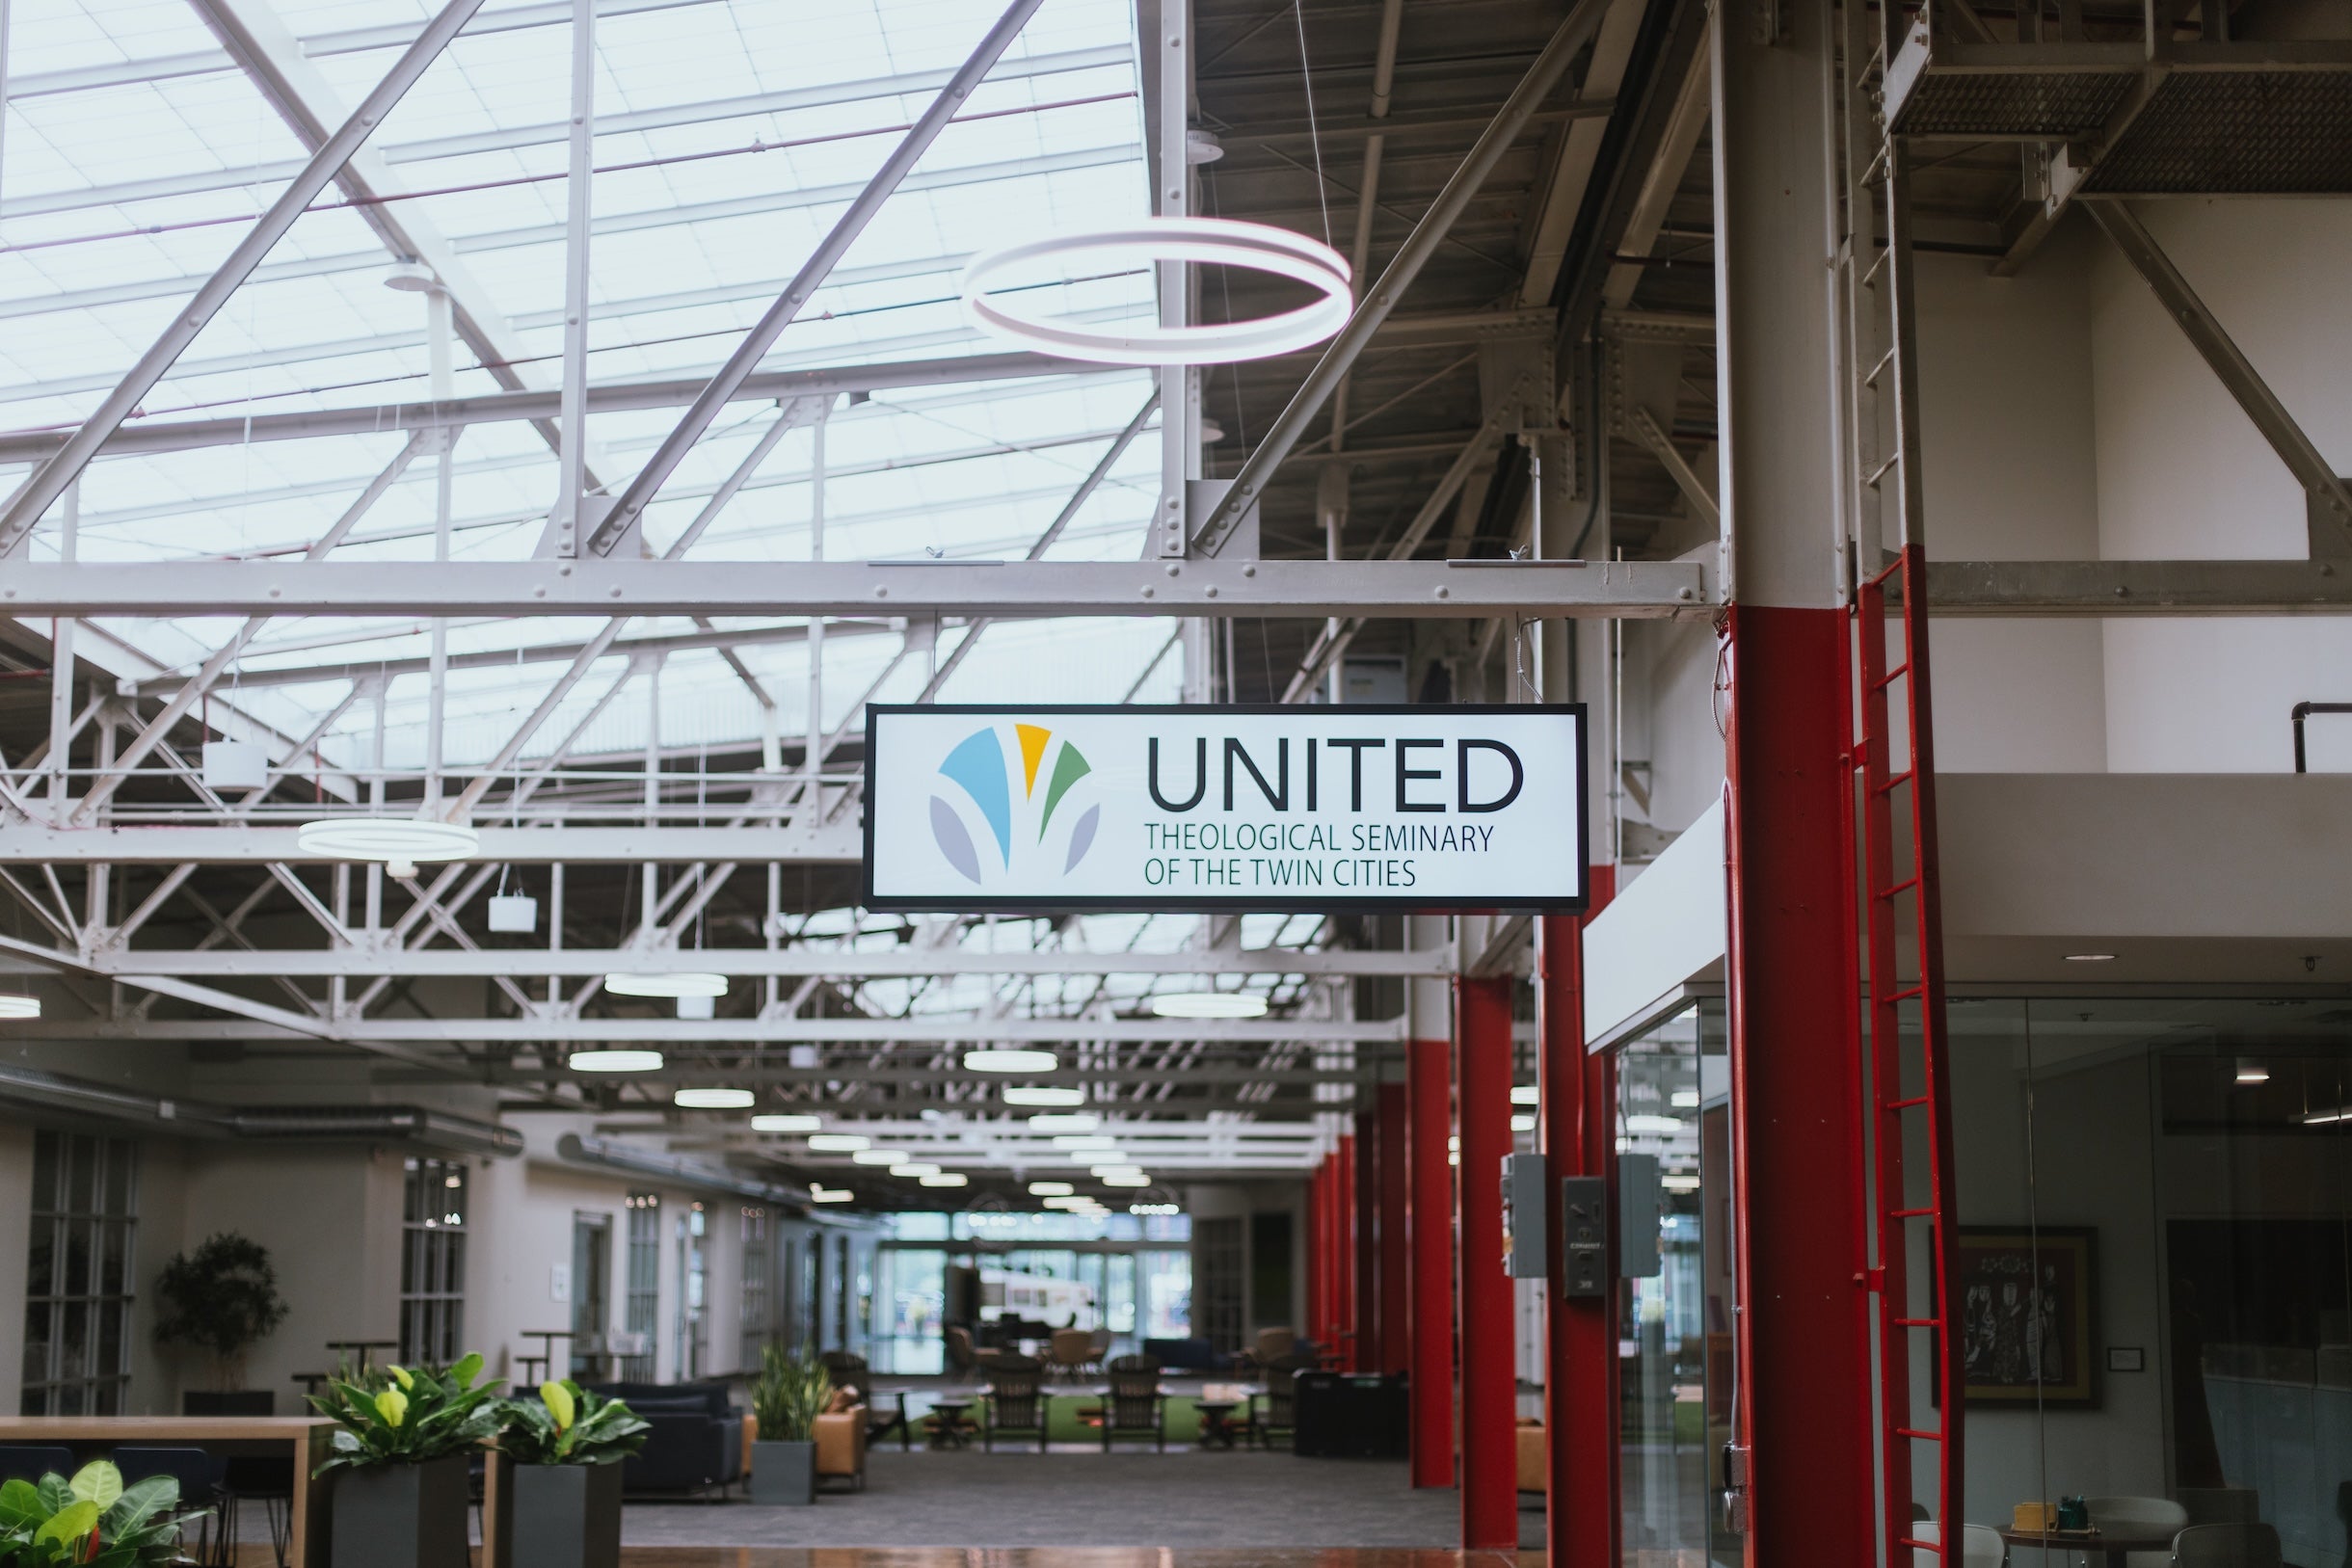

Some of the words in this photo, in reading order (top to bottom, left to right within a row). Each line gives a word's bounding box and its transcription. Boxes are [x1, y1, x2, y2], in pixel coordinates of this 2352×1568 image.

[1148, 736, 1524, 813] UNITED
[1143, 823, 1342, 851] THEOLOGICAL
[1351, 824, 1494, 853] SEMINARY
[1144, 858, 1181, 886] OF
[1189, 858, 1242, 886] THE
[1249, 859, 1323, 887] TWIN
[1333, 859, 1416, 888] CITIES
